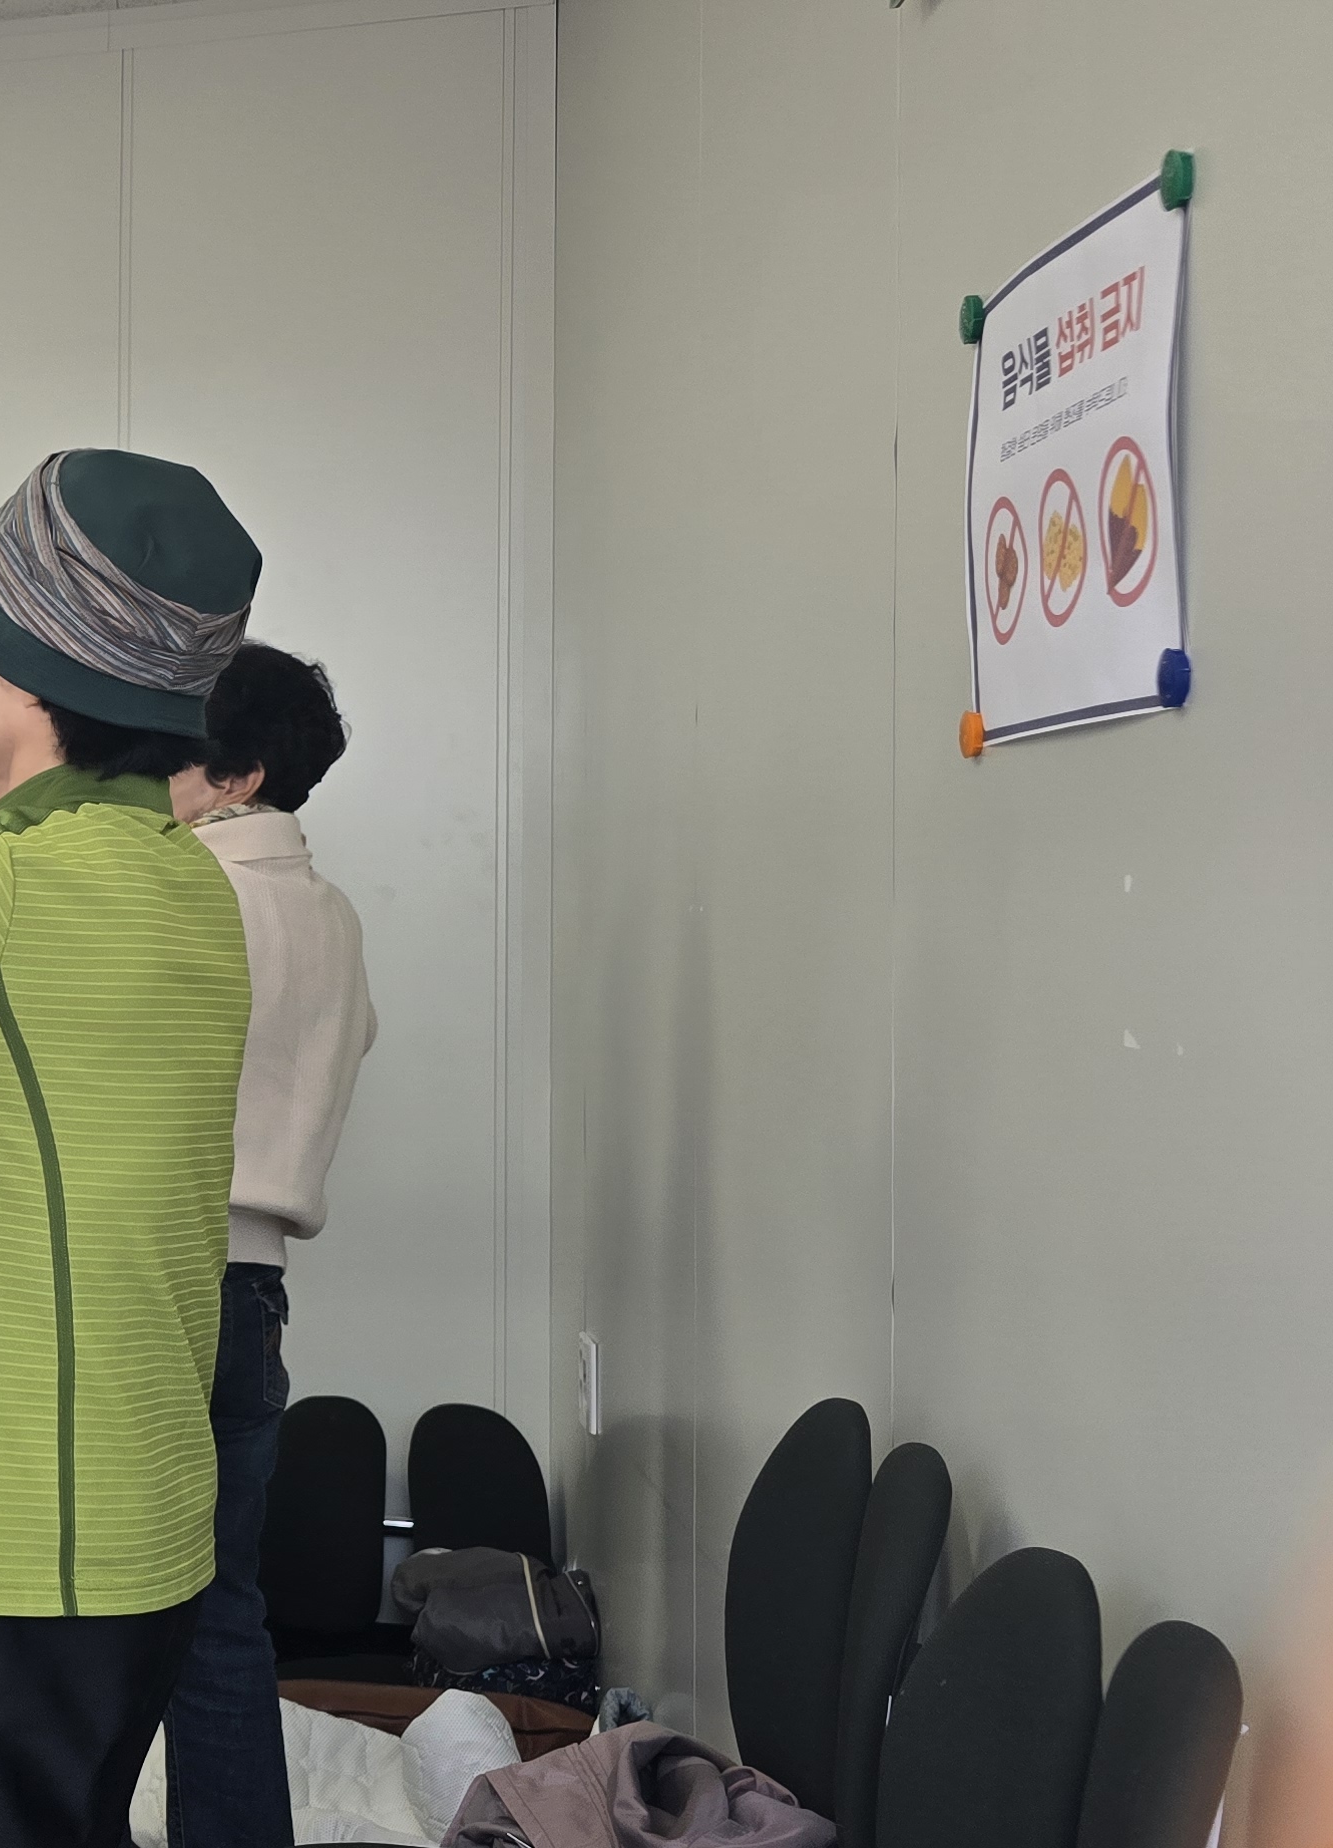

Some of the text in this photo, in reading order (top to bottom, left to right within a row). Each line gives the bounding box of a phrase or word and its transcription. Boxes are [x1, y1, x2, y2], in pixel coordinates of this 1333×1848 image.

[1001, 265, 1146, 411] 음식물 섭취 금지
